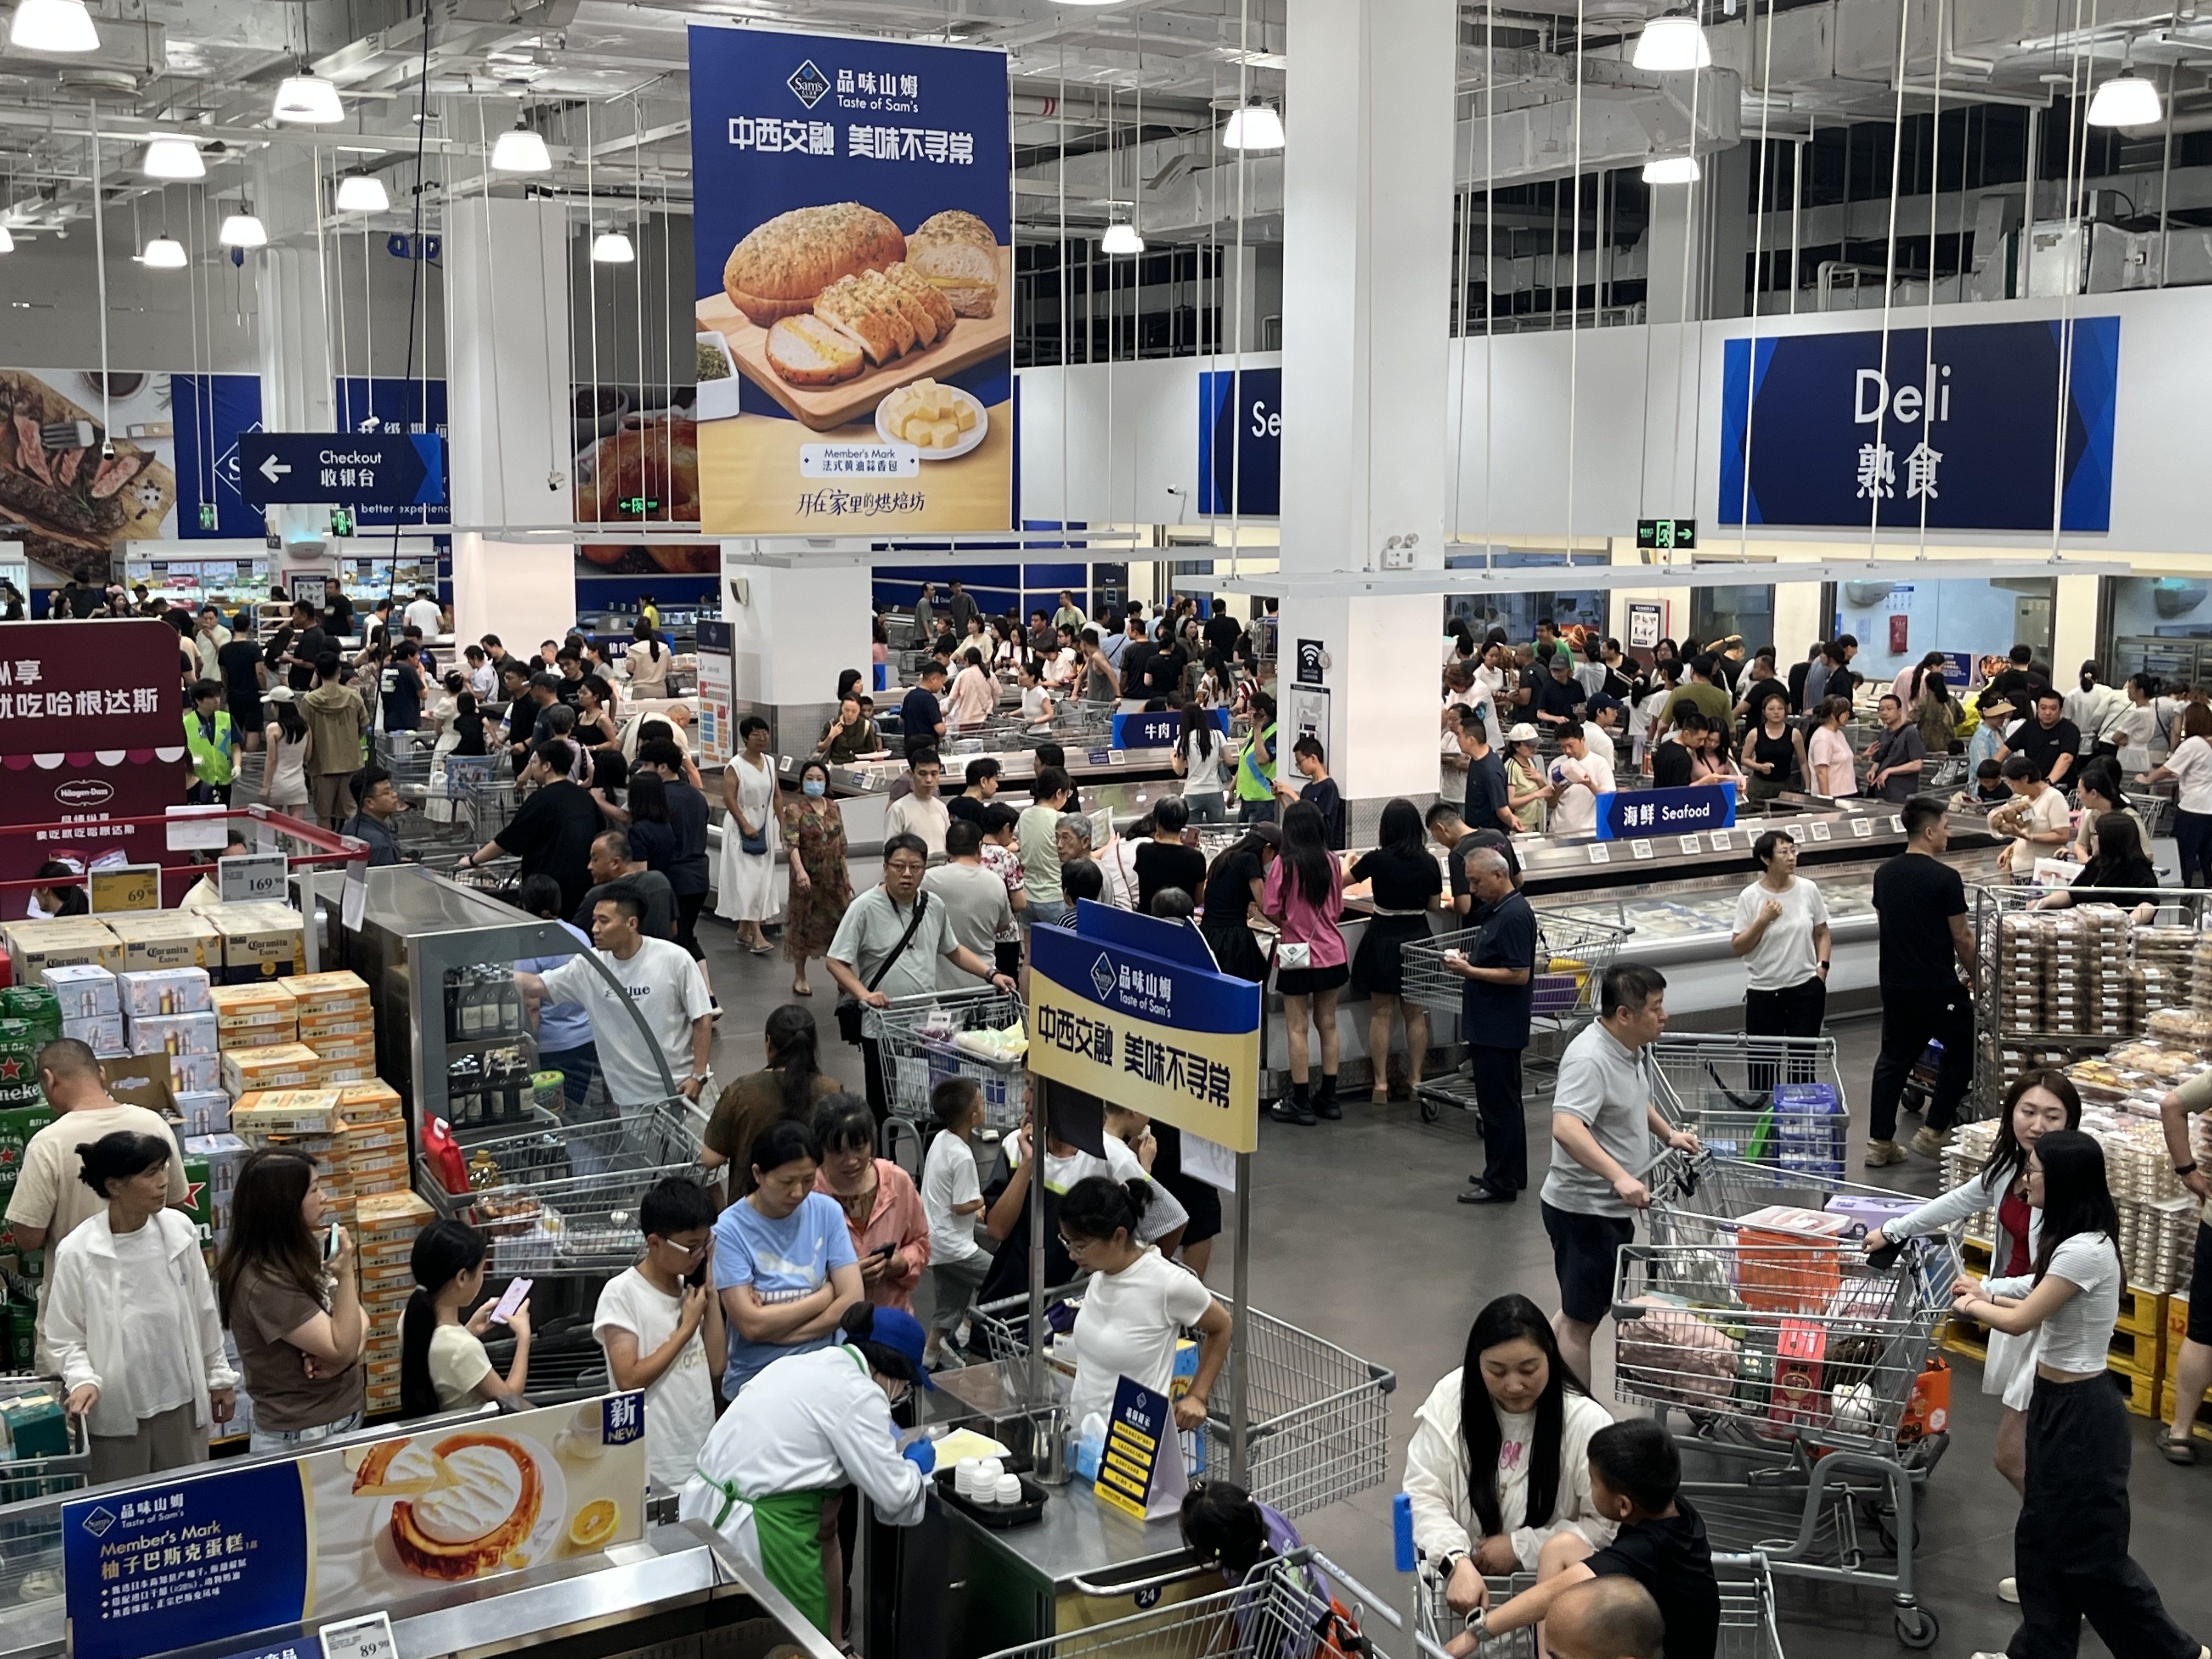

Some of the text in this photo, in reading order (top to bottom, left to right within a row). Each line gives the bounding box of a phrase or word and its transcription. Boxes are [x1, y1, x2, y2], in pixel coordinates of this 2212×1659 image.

[837, 69, 919, 99] 品味山姆
[837, 94, 919, 113] Taste of Sam's
[728, 115, 974, 165] 中西交融 美味不寻常
[1854, 364, 1951, 424] Deli
[319, 450, 382, 465] Checkout
[824, 449, 895, 459] Member's Mark
[822, 460, 898, 472] 法式黄油蒜香包
[1856, 442, 1944, 500] 熟食
[320, 469, 375, 488] 收银台
[361, 503, 394, 514] better
[1144, 722, 1170, 740] 牛肉
[1623, 802, 1710, 826] 海鲜 Seafood
[249, 878, 273, 891] 169
[128, 888, 144, 902] 69
[146, 946, 189, 958] Coronita
[247, 939, 289, 952] Coronita
[258, 949, 279, 957] Extra
[1119, 964, 1172, 1002] 品味山姆
[1119, 989, 1172, 1019] Taste of Sam's
[1038, 1004, 1231, 1109] 中西交融 美味不寻常
[609, 1395, 636, 1428] 新
[607, 1425, 640, 1442] NEW
[121, 1493, 184, 1520] 品味山姆
[122, 1509, 184, 1528] Taste of Sam's
[100, 1520, 221, 1558] Member's Mark
[101, 1533, 244, 1581] 柚子巴斯克蛋糕
[1140, 1588, 1155, 1605] 24
[360, 1642, 377, 1657] 89
